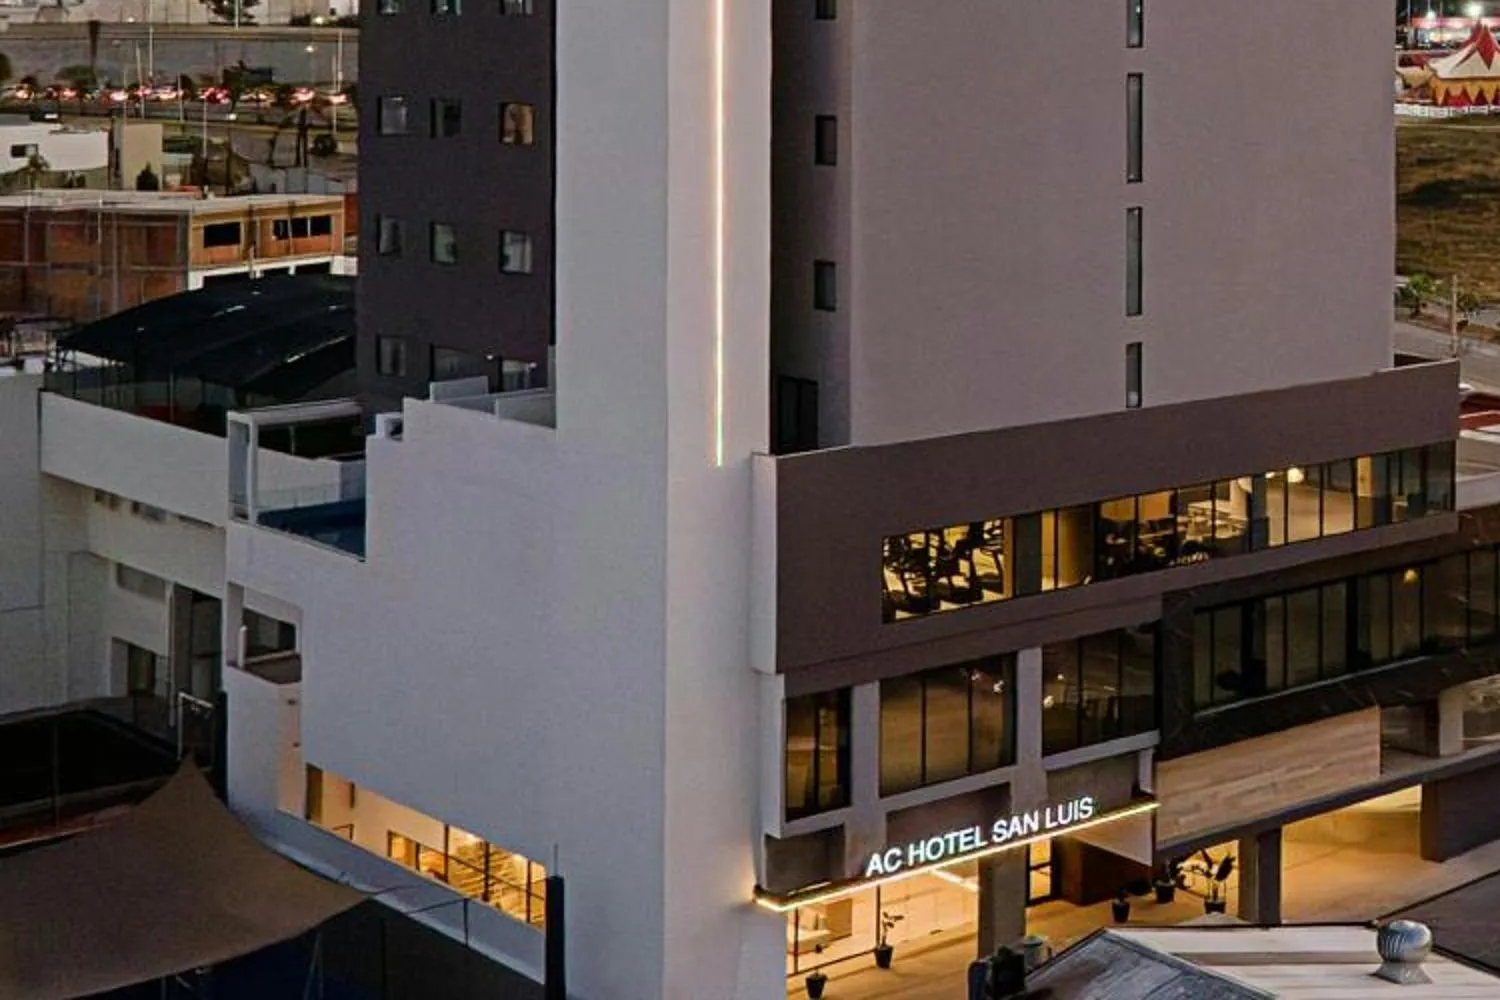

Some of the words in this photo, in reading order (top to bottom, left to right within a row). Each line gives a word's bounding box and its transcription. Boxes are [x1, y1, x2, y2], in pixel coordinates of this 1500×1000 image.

[866, 847, 903, 877] AC
[907, 827, 988, 866] HOTEL
[992, 809, 1040, 843] SAN
[1044, 797, 1094, 829] LUIS
